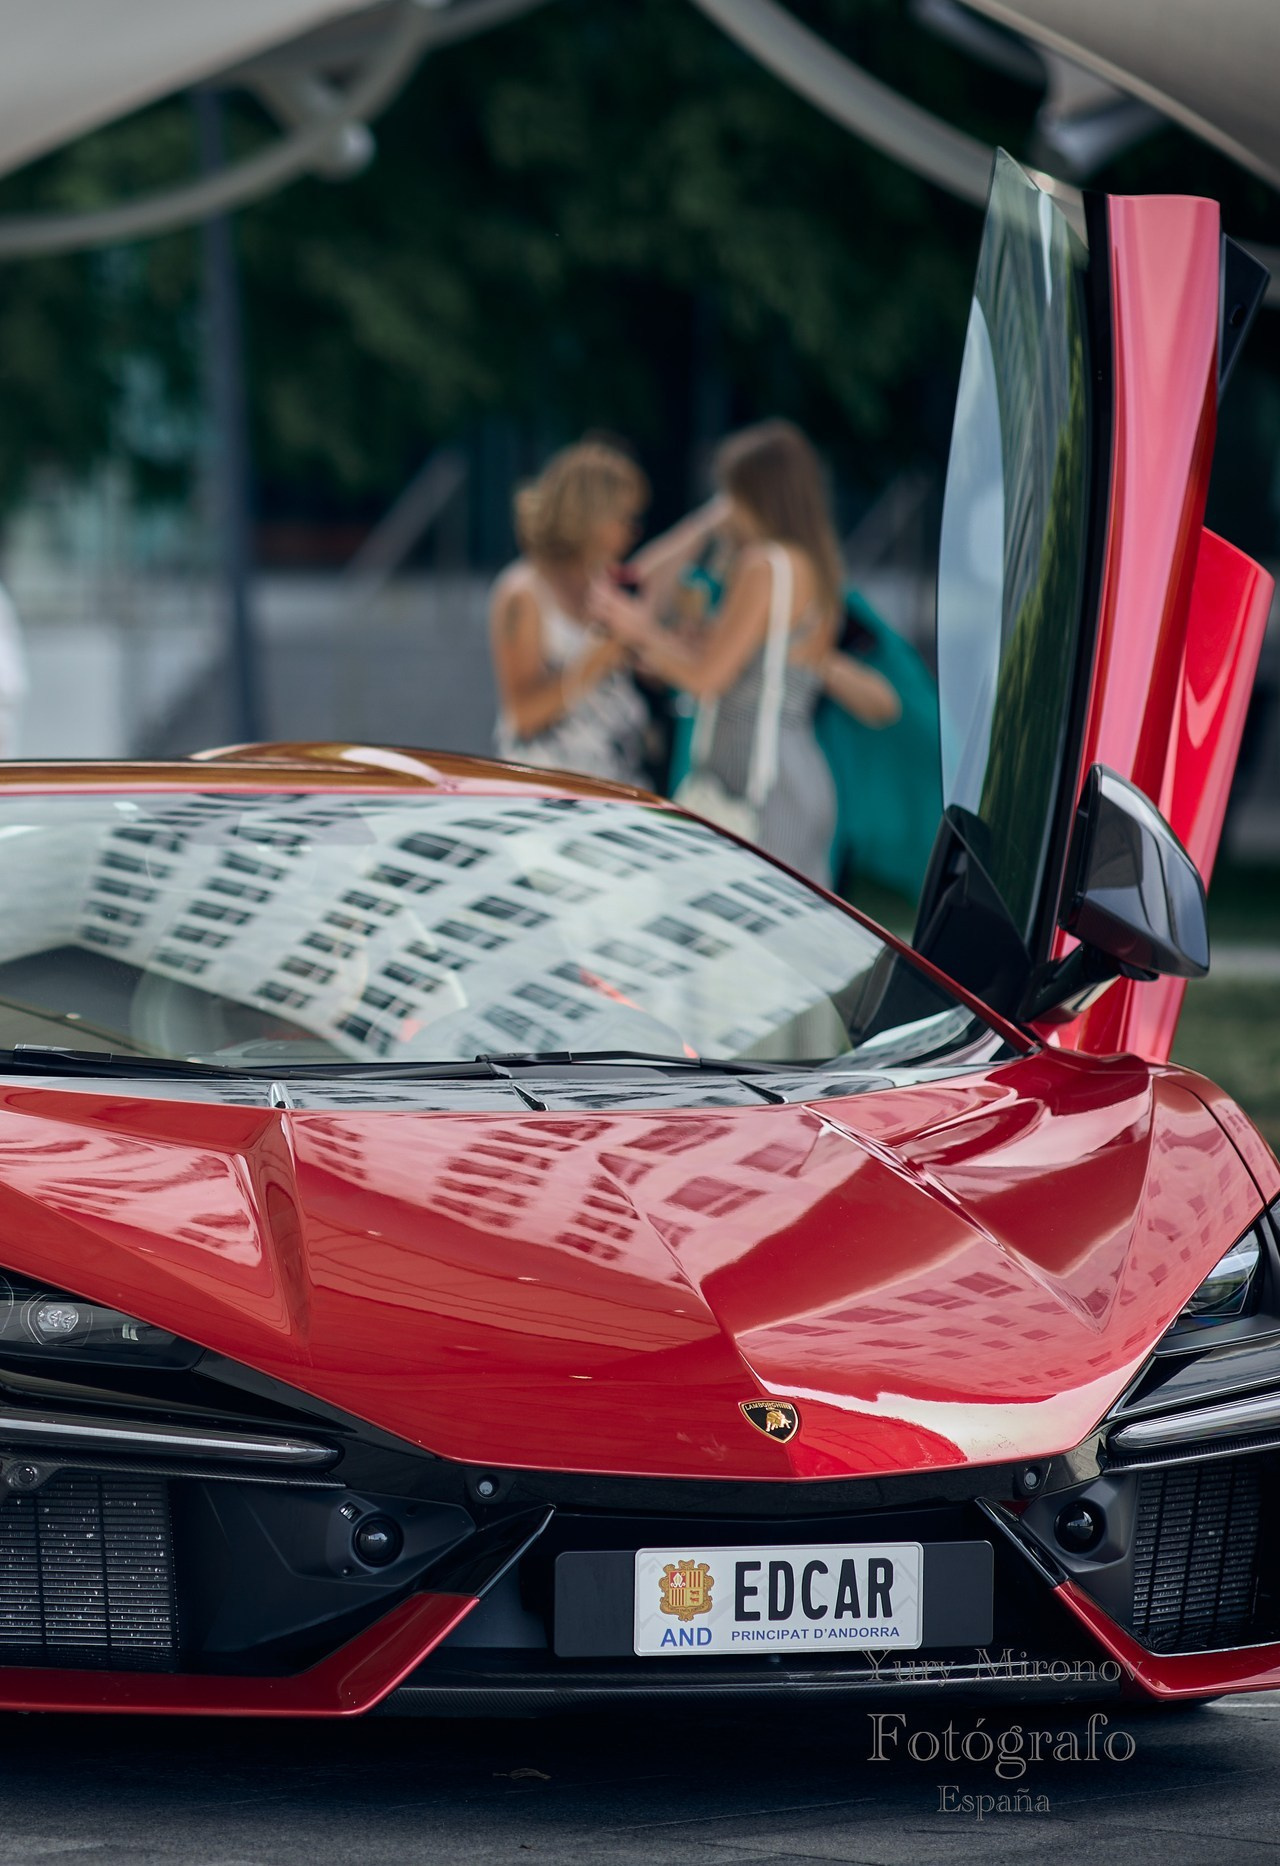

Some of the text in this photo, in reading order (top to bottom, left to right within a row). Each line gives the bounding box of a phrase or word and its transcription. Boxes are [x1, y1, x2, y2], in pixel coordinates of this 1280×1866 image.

[734, 1557, 894, 1622] EDCAR
[660, 1627, 713, 1648] AND
[731, 1626, 900, 1641] PRINCIPAT D'ANDORRA
